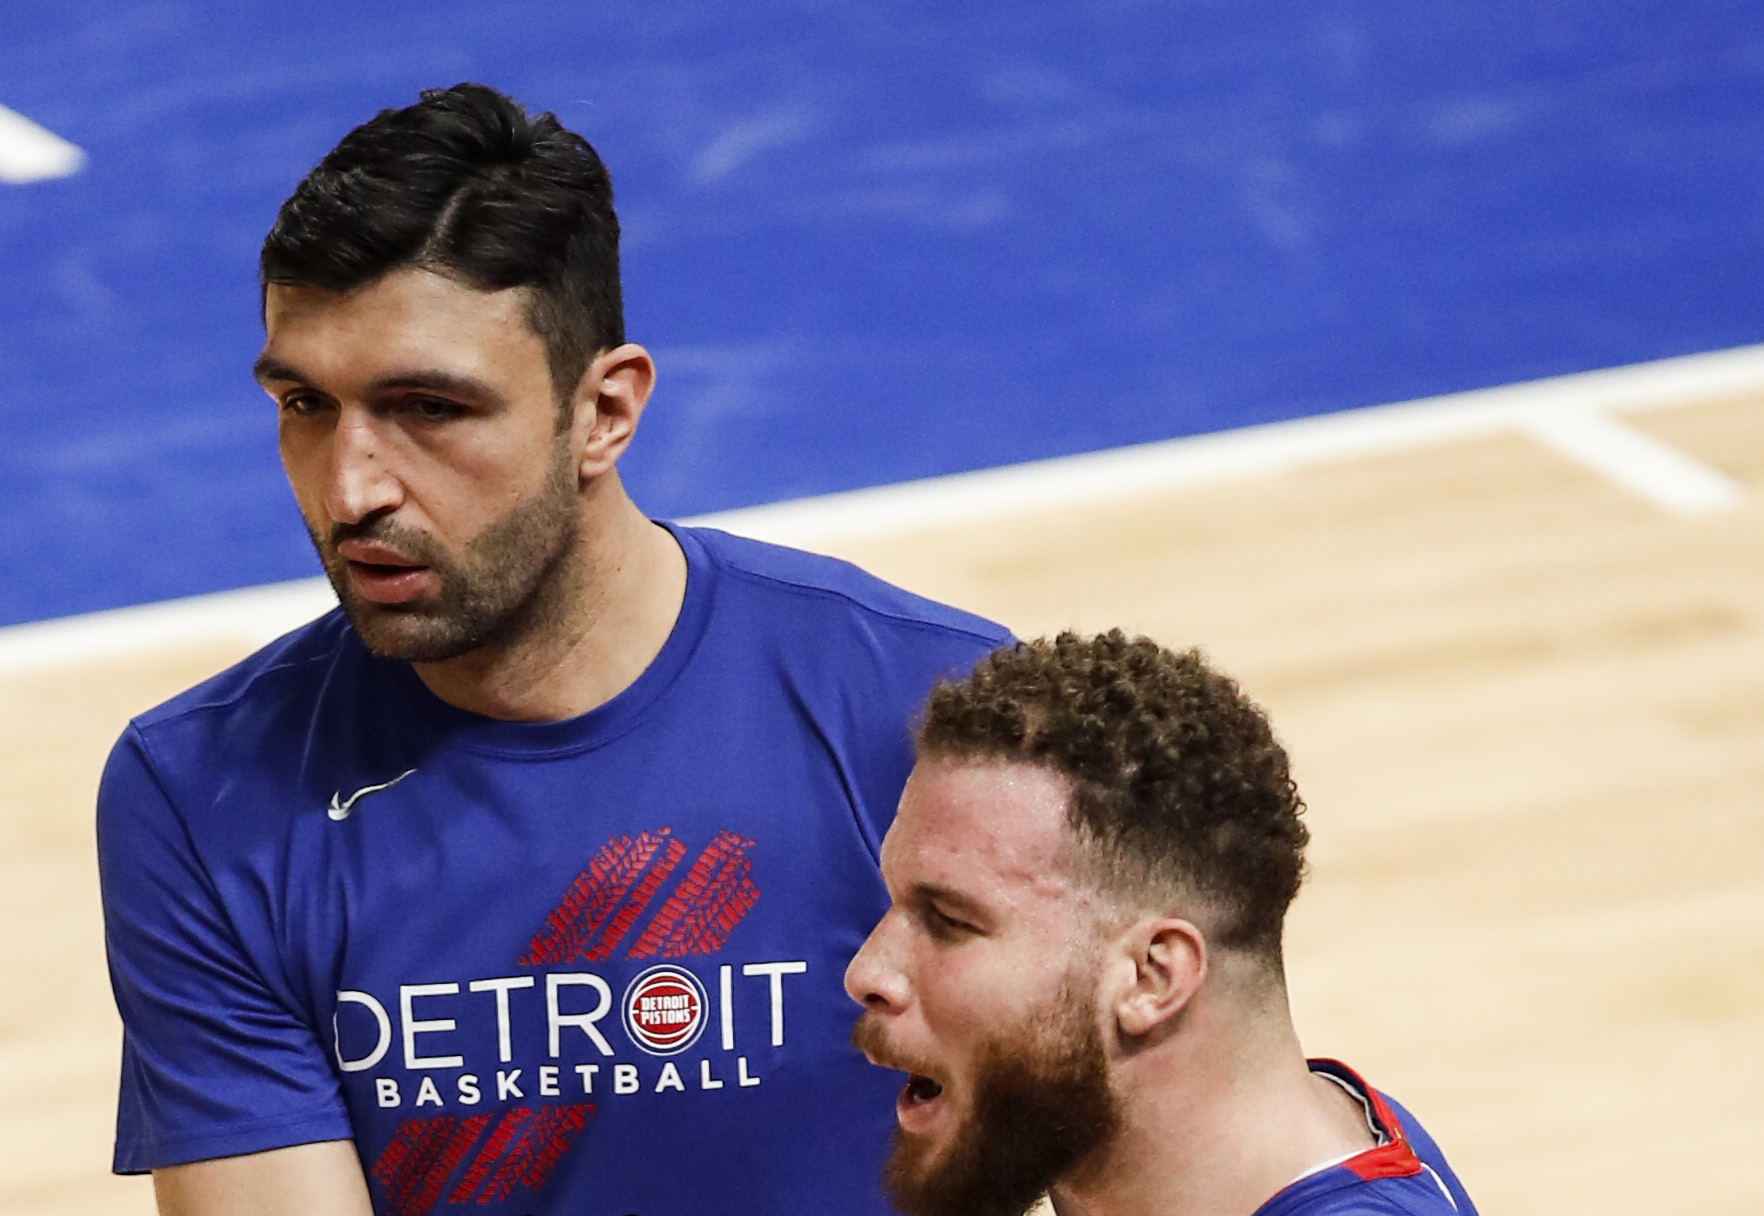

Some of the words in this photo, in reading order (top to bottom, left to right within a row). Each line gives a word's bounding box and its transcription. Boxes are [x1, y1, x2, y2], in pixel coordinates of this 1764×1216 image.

[334, 961, 807, 1072] DETROIT
[641, 995, 689, 1010] DETROIT
[641, 1009, 690, 1025] PISTONS
[376, 1056, 761, 1108] BASKETBALL
